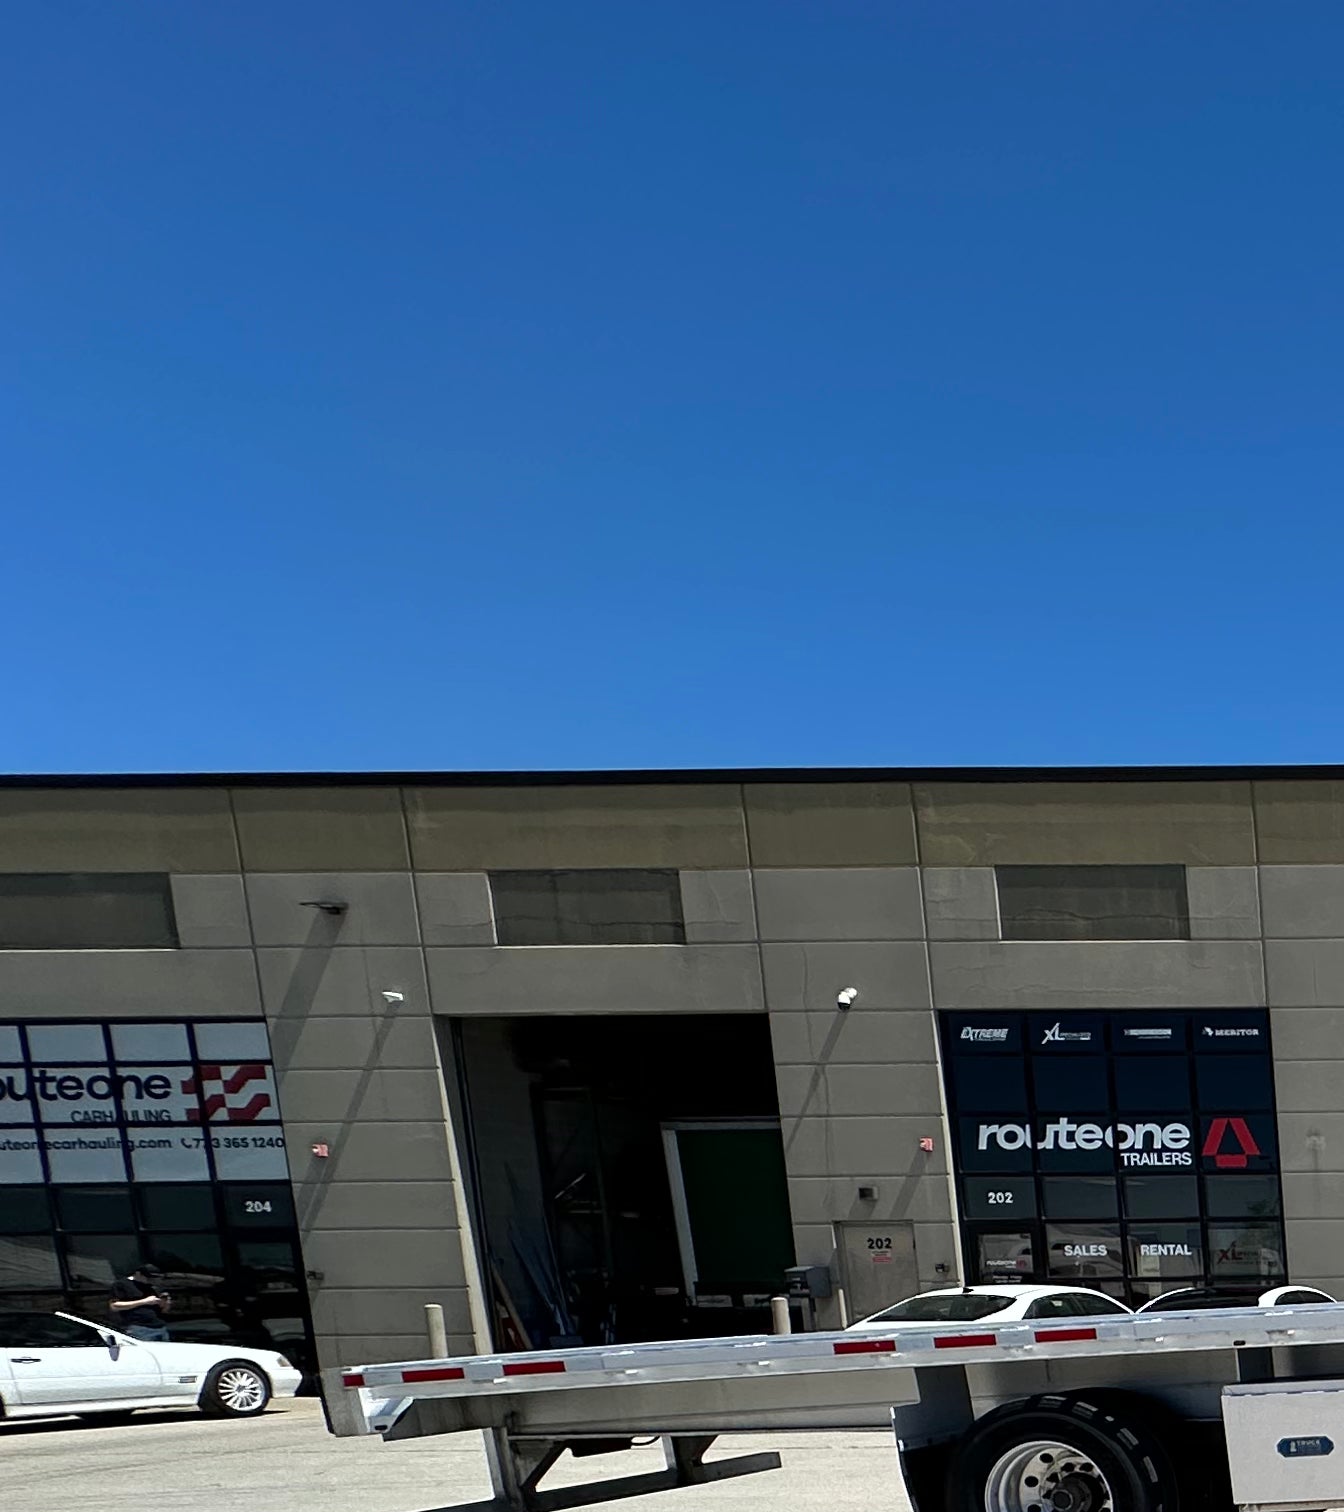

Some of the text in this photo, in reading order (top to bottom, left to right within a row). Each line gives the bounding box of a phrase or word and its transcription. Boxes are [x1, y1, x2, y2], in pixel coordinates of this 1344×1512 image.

[0, 1070, 172, 1101] uteone
[70, 1109, 172, 1122] CARHULING
[978, 1117, 1191, 1151] routeone
[223, 1137, 249, 1149] 365
[1120, 1152, 1193, 1166] TRAILERS
[987, 1191, 1014, 1204] 202
[245, 1201, 272, 1213] 204
[866, 1237, 892, 1249] 202
[1140, 1243, 1193, 1256] RENTAL
[1063, 1244, 1108, 1256] SALES
